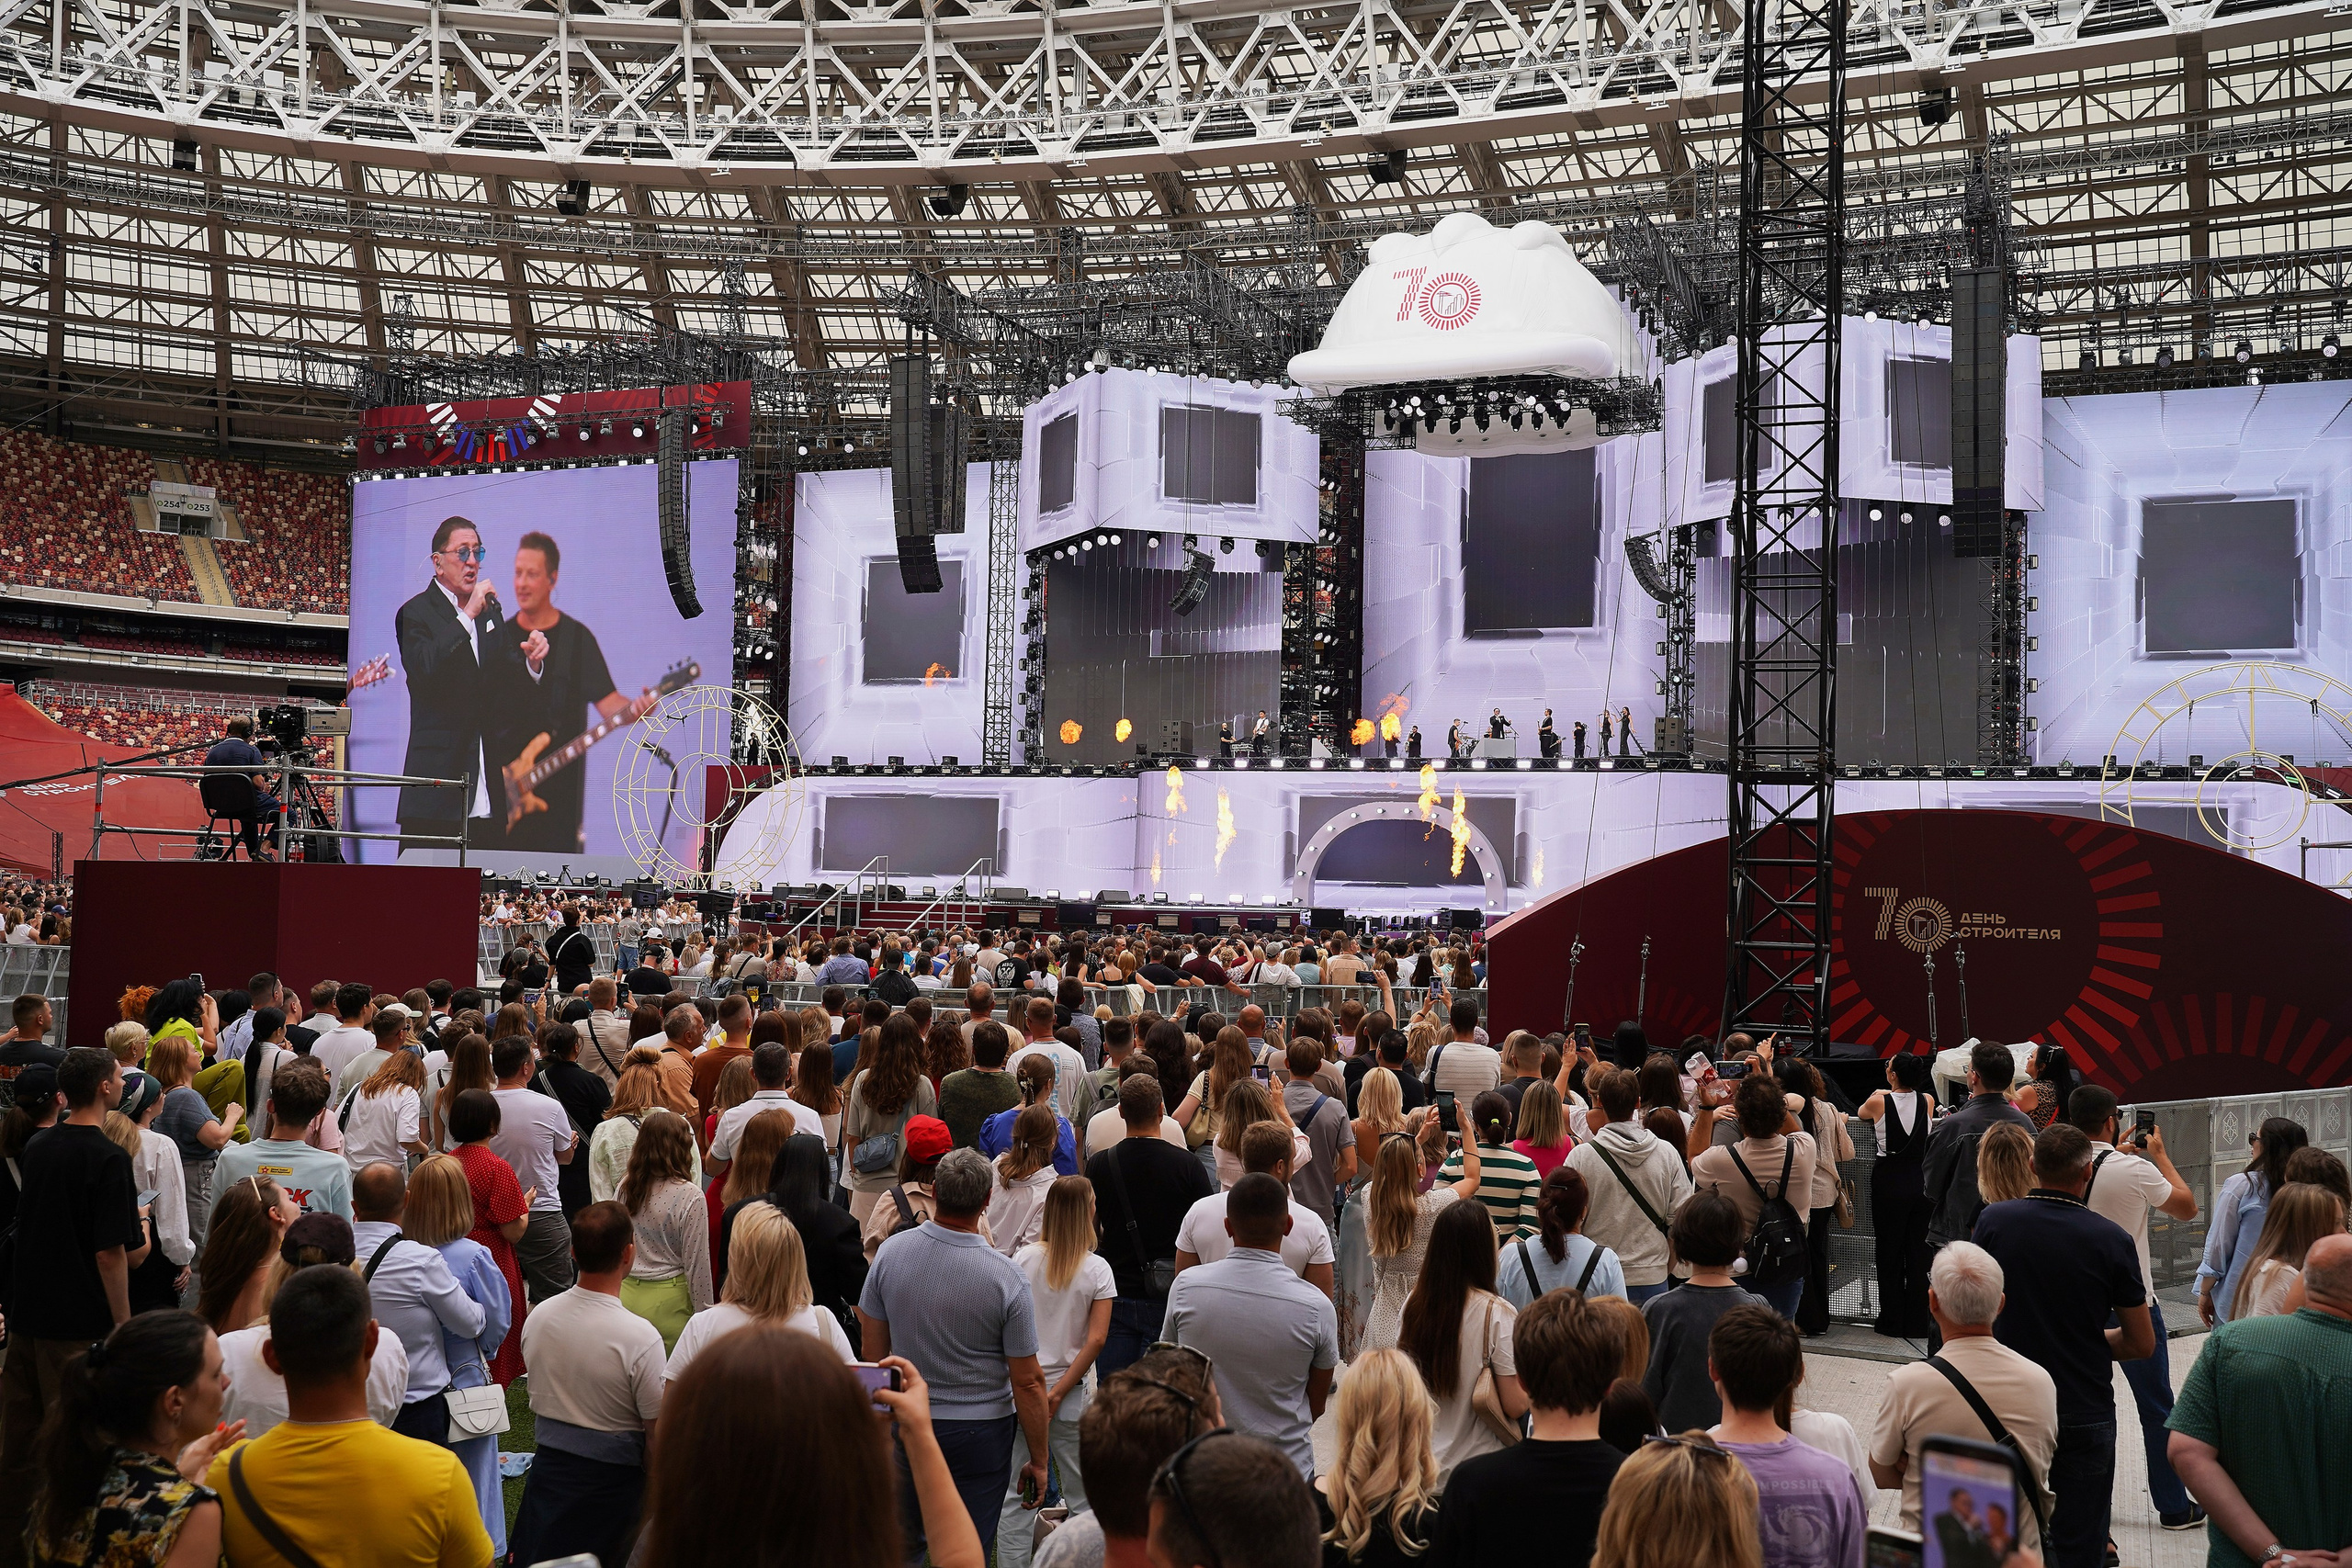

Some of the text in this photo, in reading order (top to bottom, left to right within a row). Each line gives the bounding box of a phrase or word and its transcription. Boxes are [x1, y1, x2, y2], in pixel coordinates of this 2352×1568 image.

[164, 500, 180, 508] 254
[193, 503, 210, 513] 253
[22, 773, 148, 796] СТРОИЕЛ
[1960, 912, 2007, 924] ДЕНЬ
[1960, 926, 2062, 941] СТРОИТЕЛЯ
[1759, 1479, 1833, 1491] MPOSSIBLE
